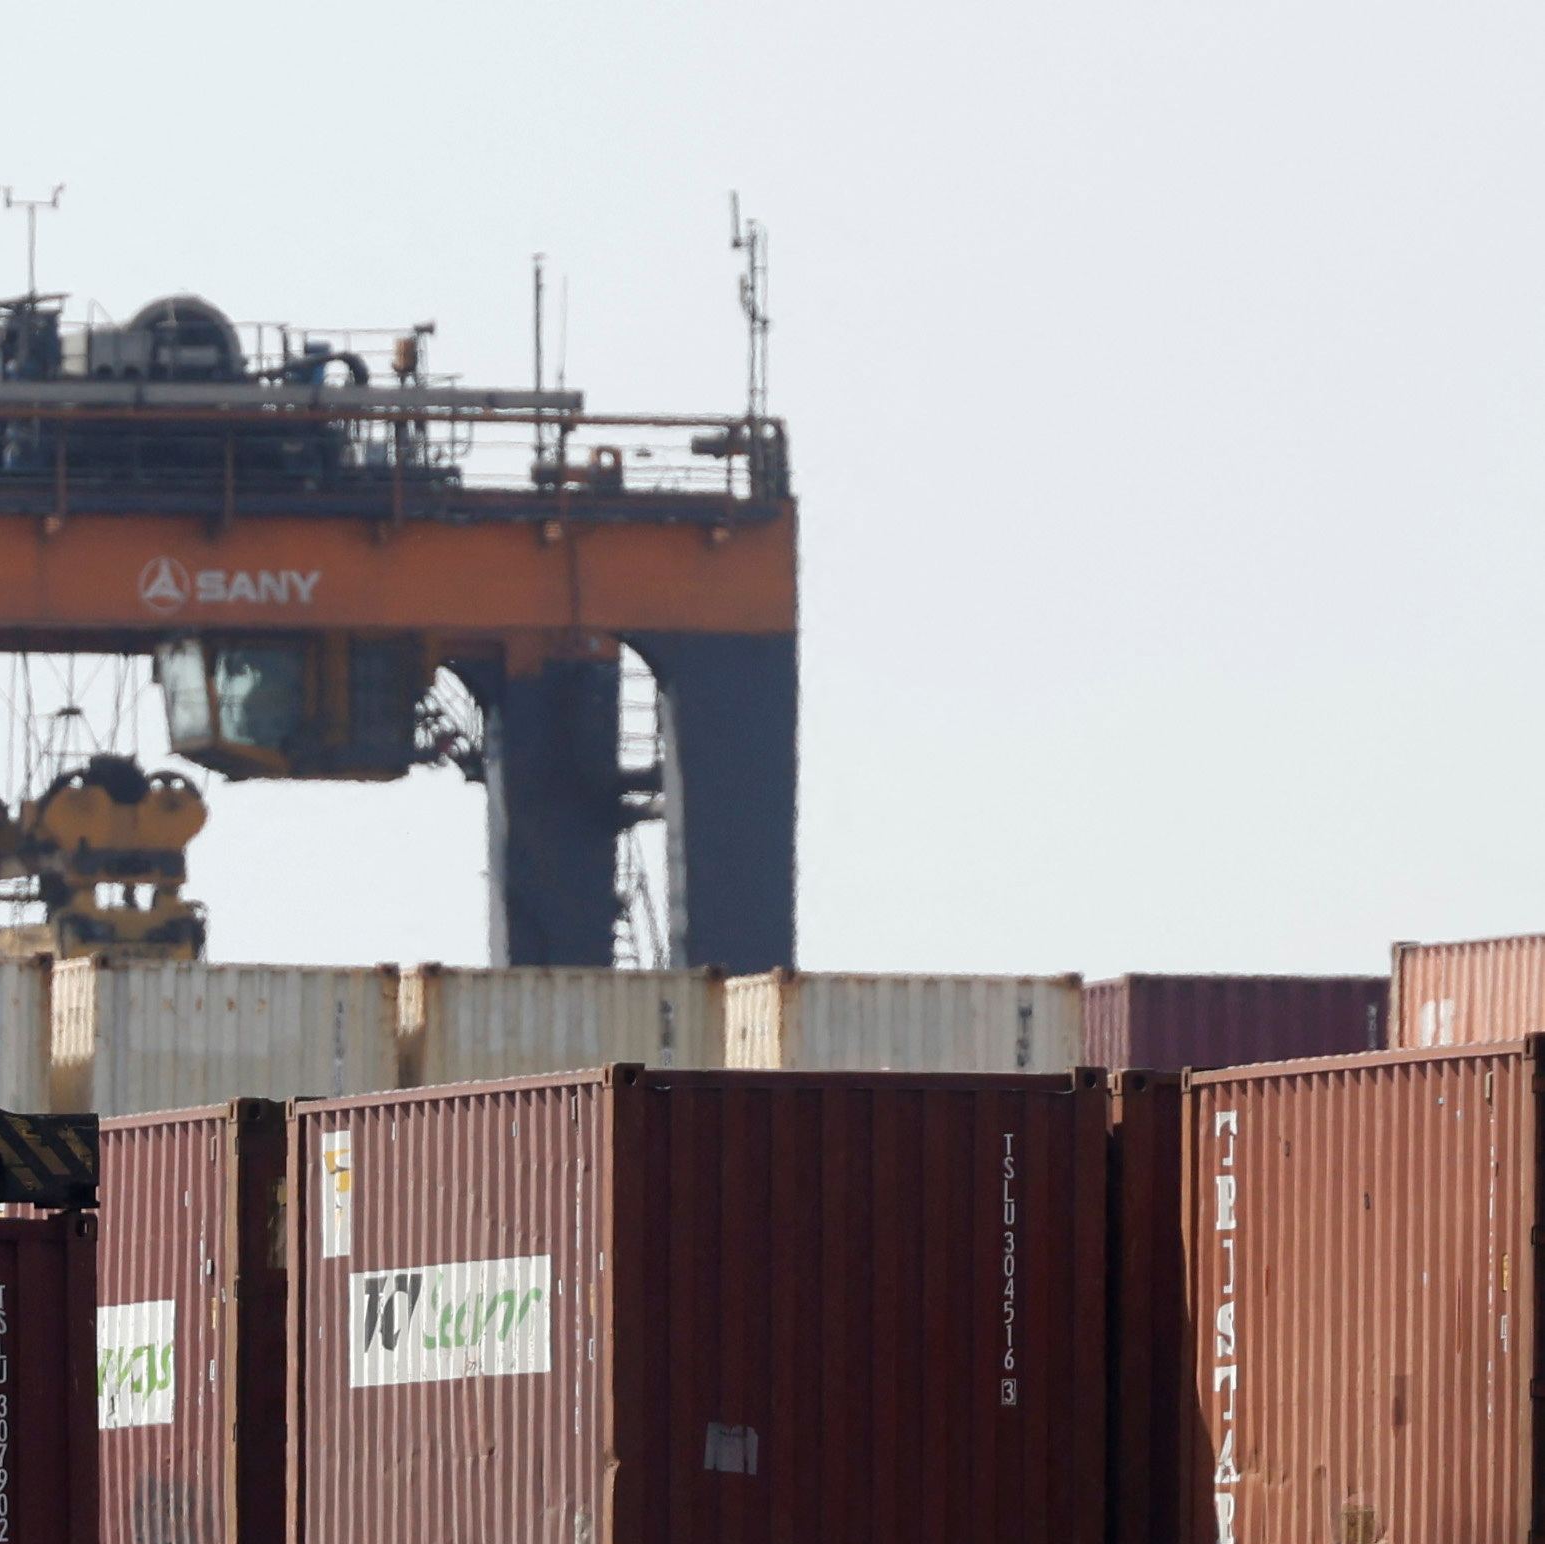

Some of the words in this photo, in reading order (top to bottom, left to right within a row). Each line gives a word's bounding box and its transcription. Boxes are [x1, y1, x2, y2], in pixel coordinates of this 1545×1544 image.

[195, 570, 321, 603] SANY
[1003, 1133, 1016, 1225] TSLU
[1003, 1232, 1016, 1371] 304516
[1002, 1379, 1016, 1405] 3
